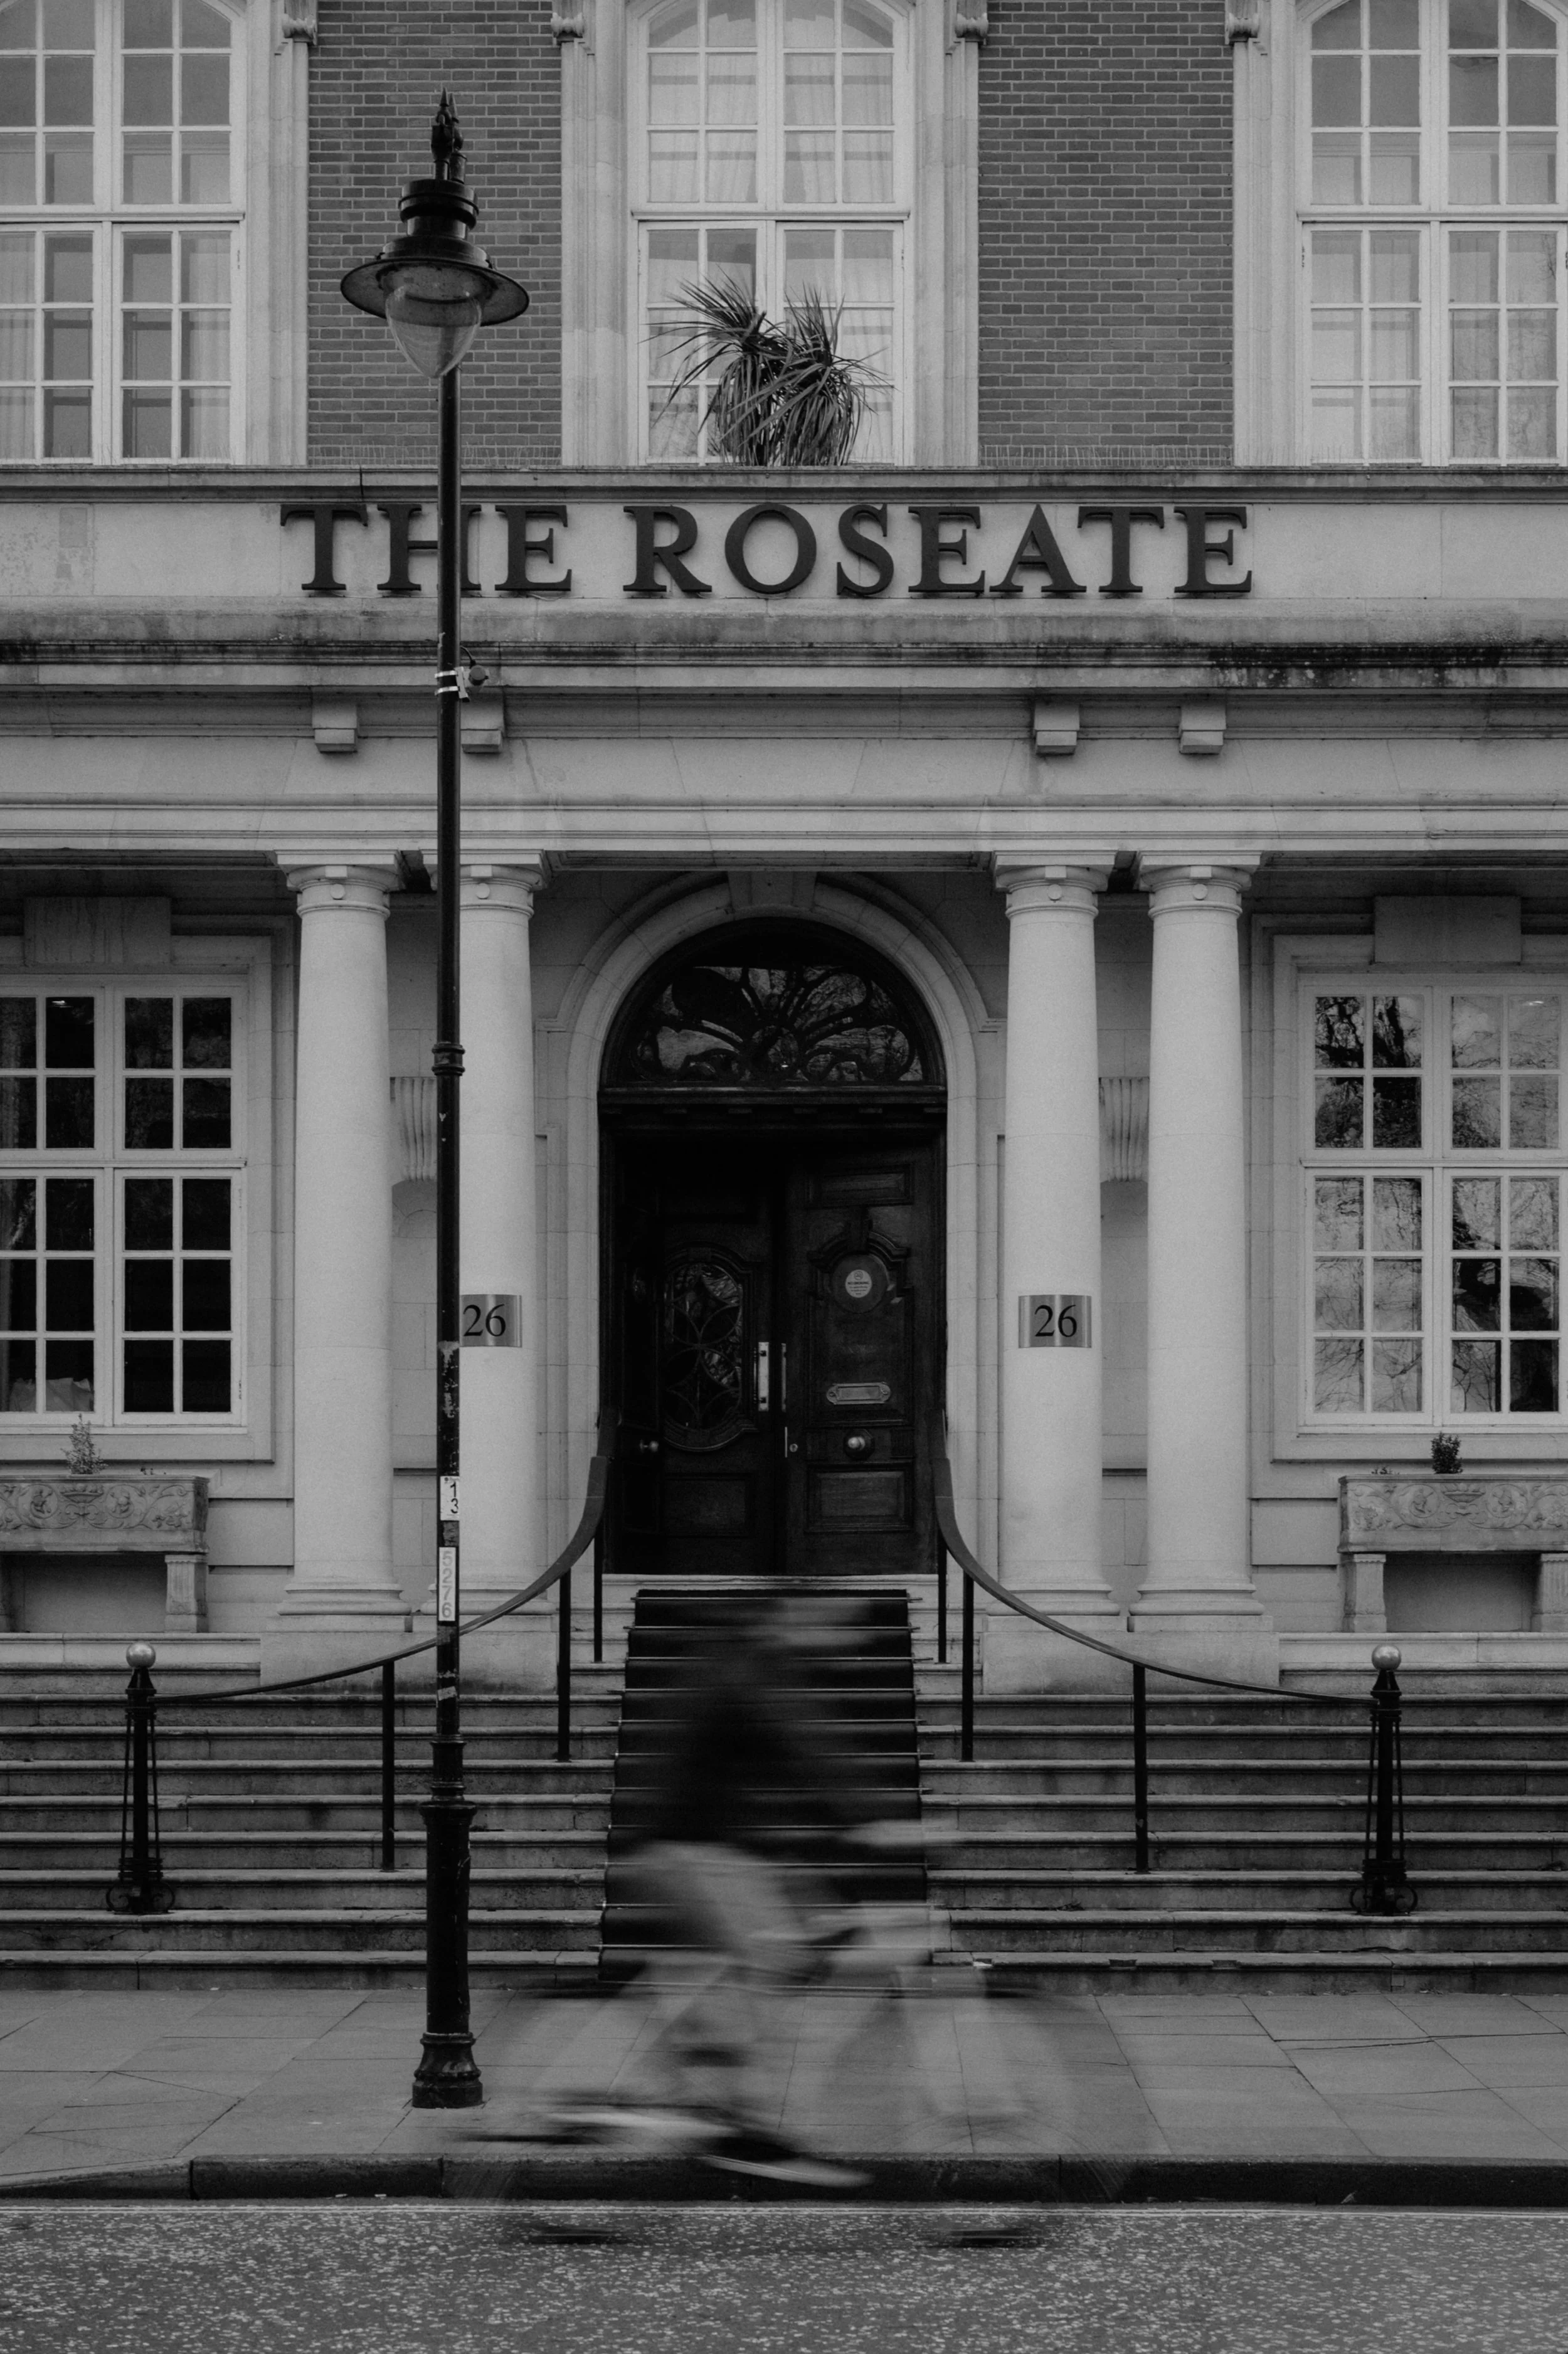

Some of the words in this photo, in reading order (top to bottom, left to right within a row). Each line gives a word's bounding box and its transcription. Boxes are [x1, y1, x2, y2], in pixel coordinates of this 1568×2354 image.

[280, 504, 572, 591] THE
[623, 503, 1253, 594] ROSEATE
[463, 1303, 506, 1337] 26
[1035, 1304, 1077, 1337] 26
